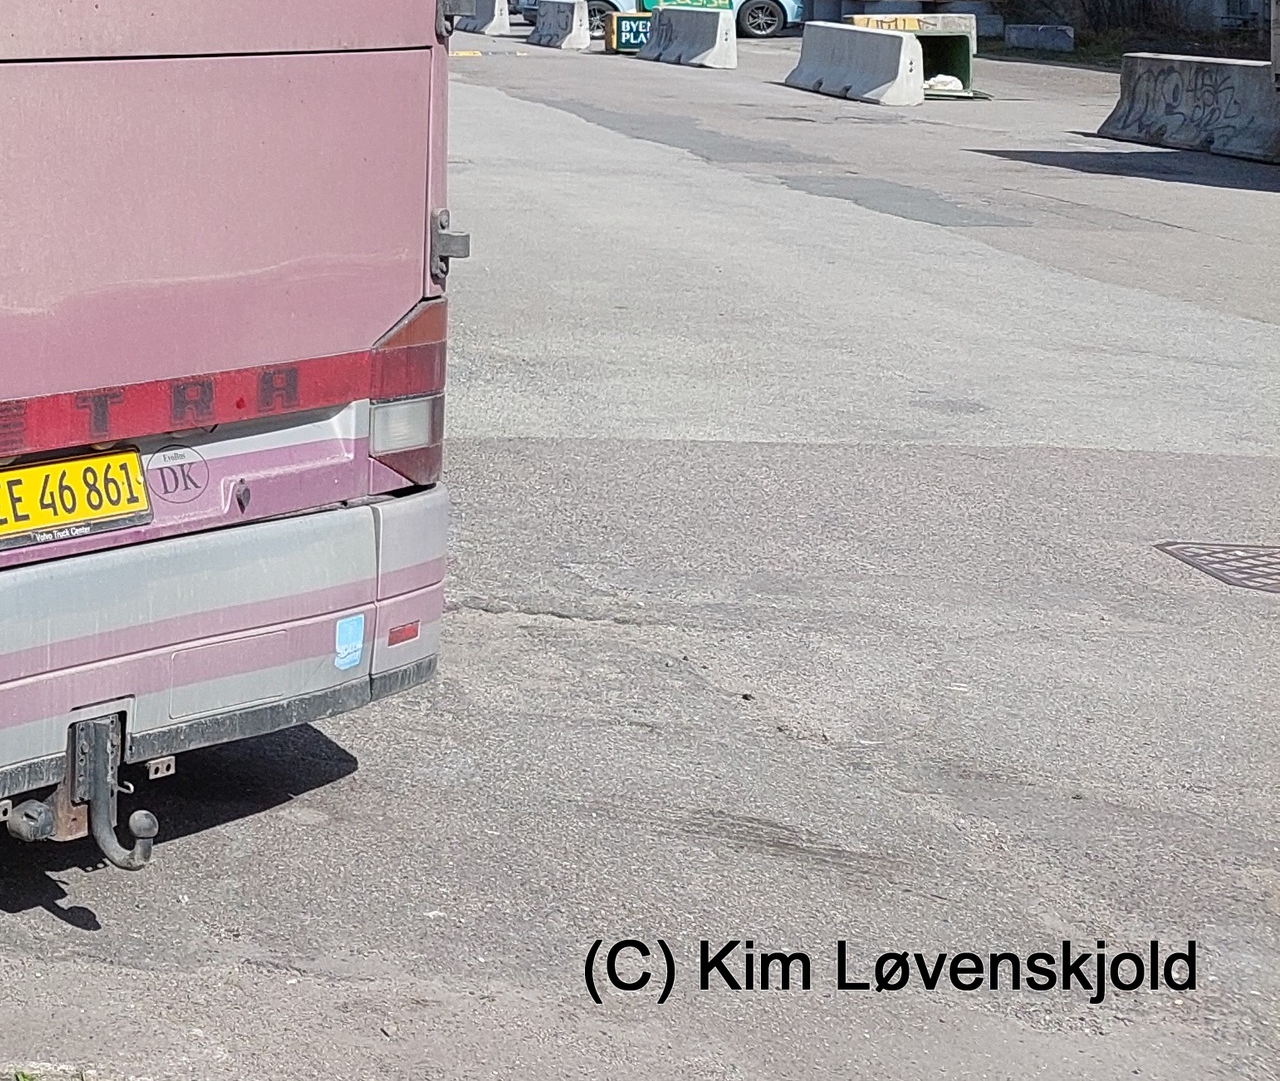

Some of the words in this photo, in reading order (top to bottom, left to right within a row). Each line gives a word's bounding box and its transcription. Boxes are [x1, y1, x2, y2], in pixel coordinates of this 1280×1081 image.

[621, 32, 650, 44] PLA
[39, 469, 77, 517] 46
[81, 462, 140, 511] 861
[157, 462, 202, 495] DK
[35, 532, 53, 542] Volvo
[53, 529, 70, 539] Truck
